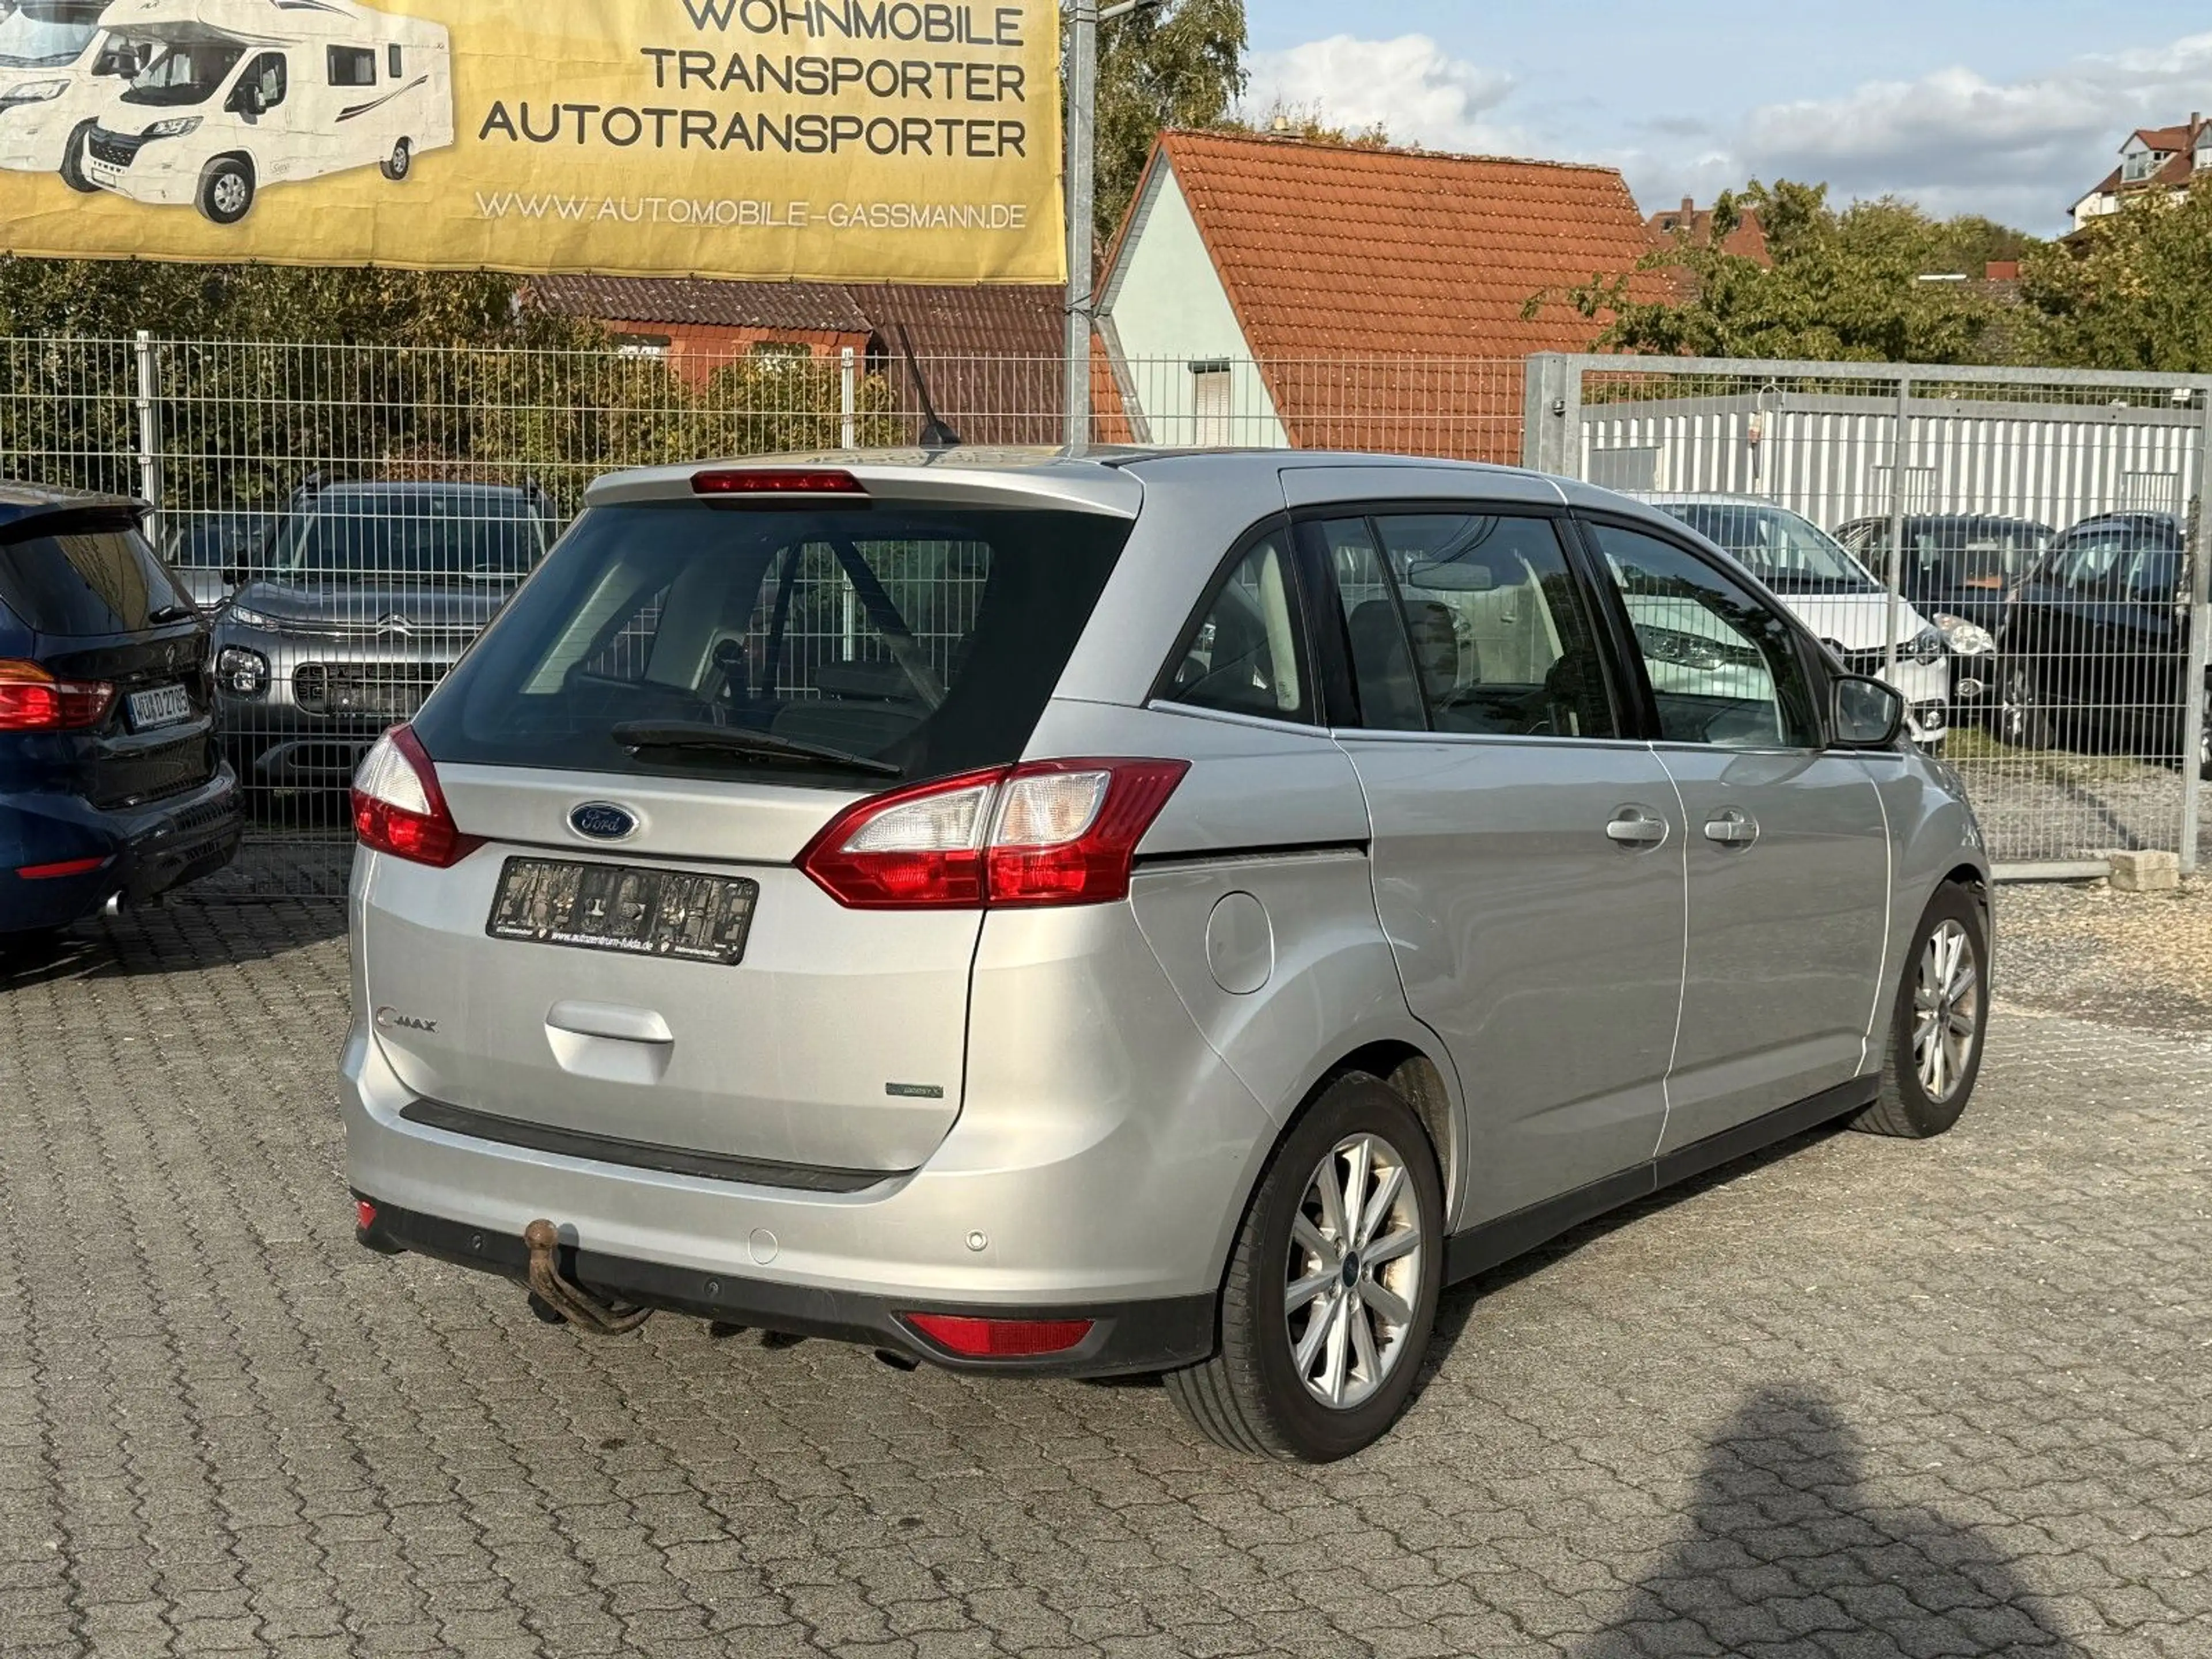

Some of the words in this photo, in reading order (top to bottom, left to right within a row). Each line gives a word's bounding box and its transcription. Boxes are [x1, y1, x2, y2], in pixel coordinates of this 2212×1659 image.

[683, 0, 1024, 46] WOHNMOBILE
[641, 48, 1026, 102] TRANSPORTER
[478, 100, 1026, 157] AUTOTRANSPORTER
[476, 191, 1027, 229] WWW.AUTOMOBILE-GASSMANN.DE
[581, 809, 620, 831] Ford
